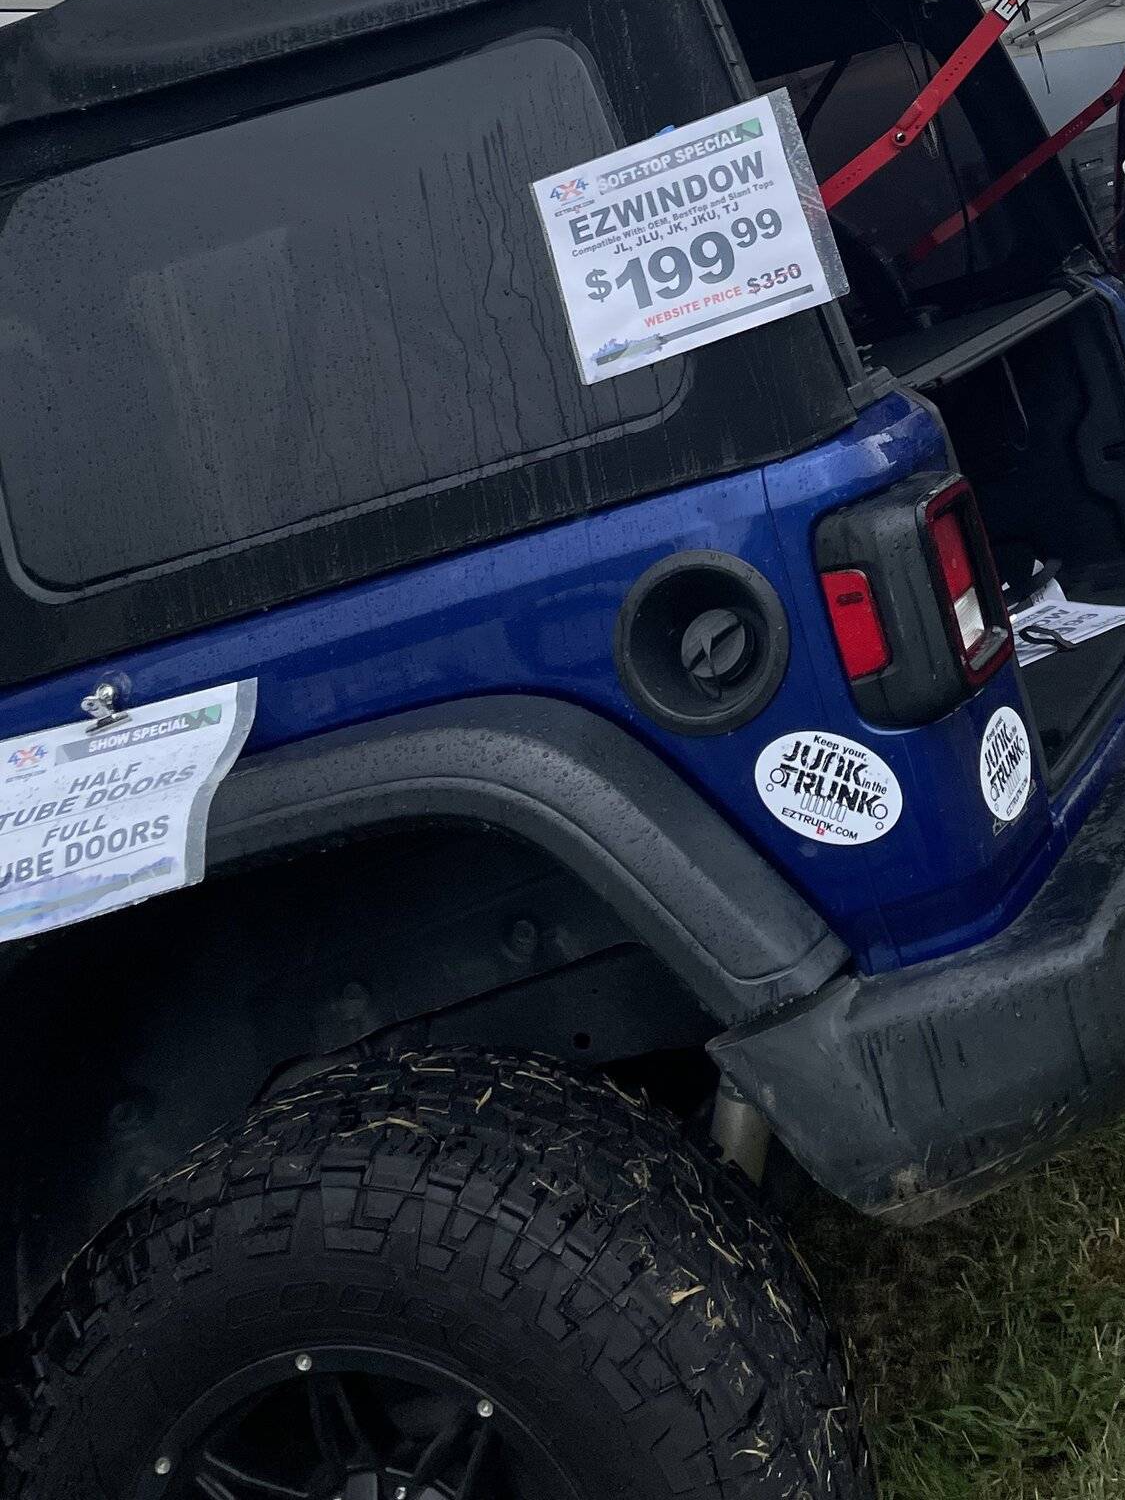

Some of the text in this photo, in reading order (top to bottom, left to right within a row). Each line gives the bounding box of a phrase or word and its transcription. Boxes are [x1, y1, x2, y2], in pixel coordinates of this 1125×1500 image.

[598, 129, 742, 192] SOFT-TOP SPECIAL
[568, 150, 765, 246] EZWINDOW
[571, 234, 622, 257] Compatible
[622, 226, 646, 242] With:
[710, 196, 727, 208] and
[752, 179, 775, 193] Tops
[613, 201, 741, 255] JL, JLU, JK, JKU, TJ
[643, 263, 803, 328] WEBSITE PRICE $350
[88, 717, 190, 753] SHOW SPECIAL
[813, 735, 867, 761] Keep your
[984, 722, 1013, 777] JUNK
[68, 761, 143, 794] HALF
[84, 765, 198, 809] DOORS
[779, 763, 883, 818] TRUNK
[782, 740, 869, 787] JUNK
[871, 779, 888, 795] the
[0, 814, 170, 889] UBE DOORS
[42, 814, 109, 848] FULL
[781, 807, 859, 841] EZTRUNK.COM
